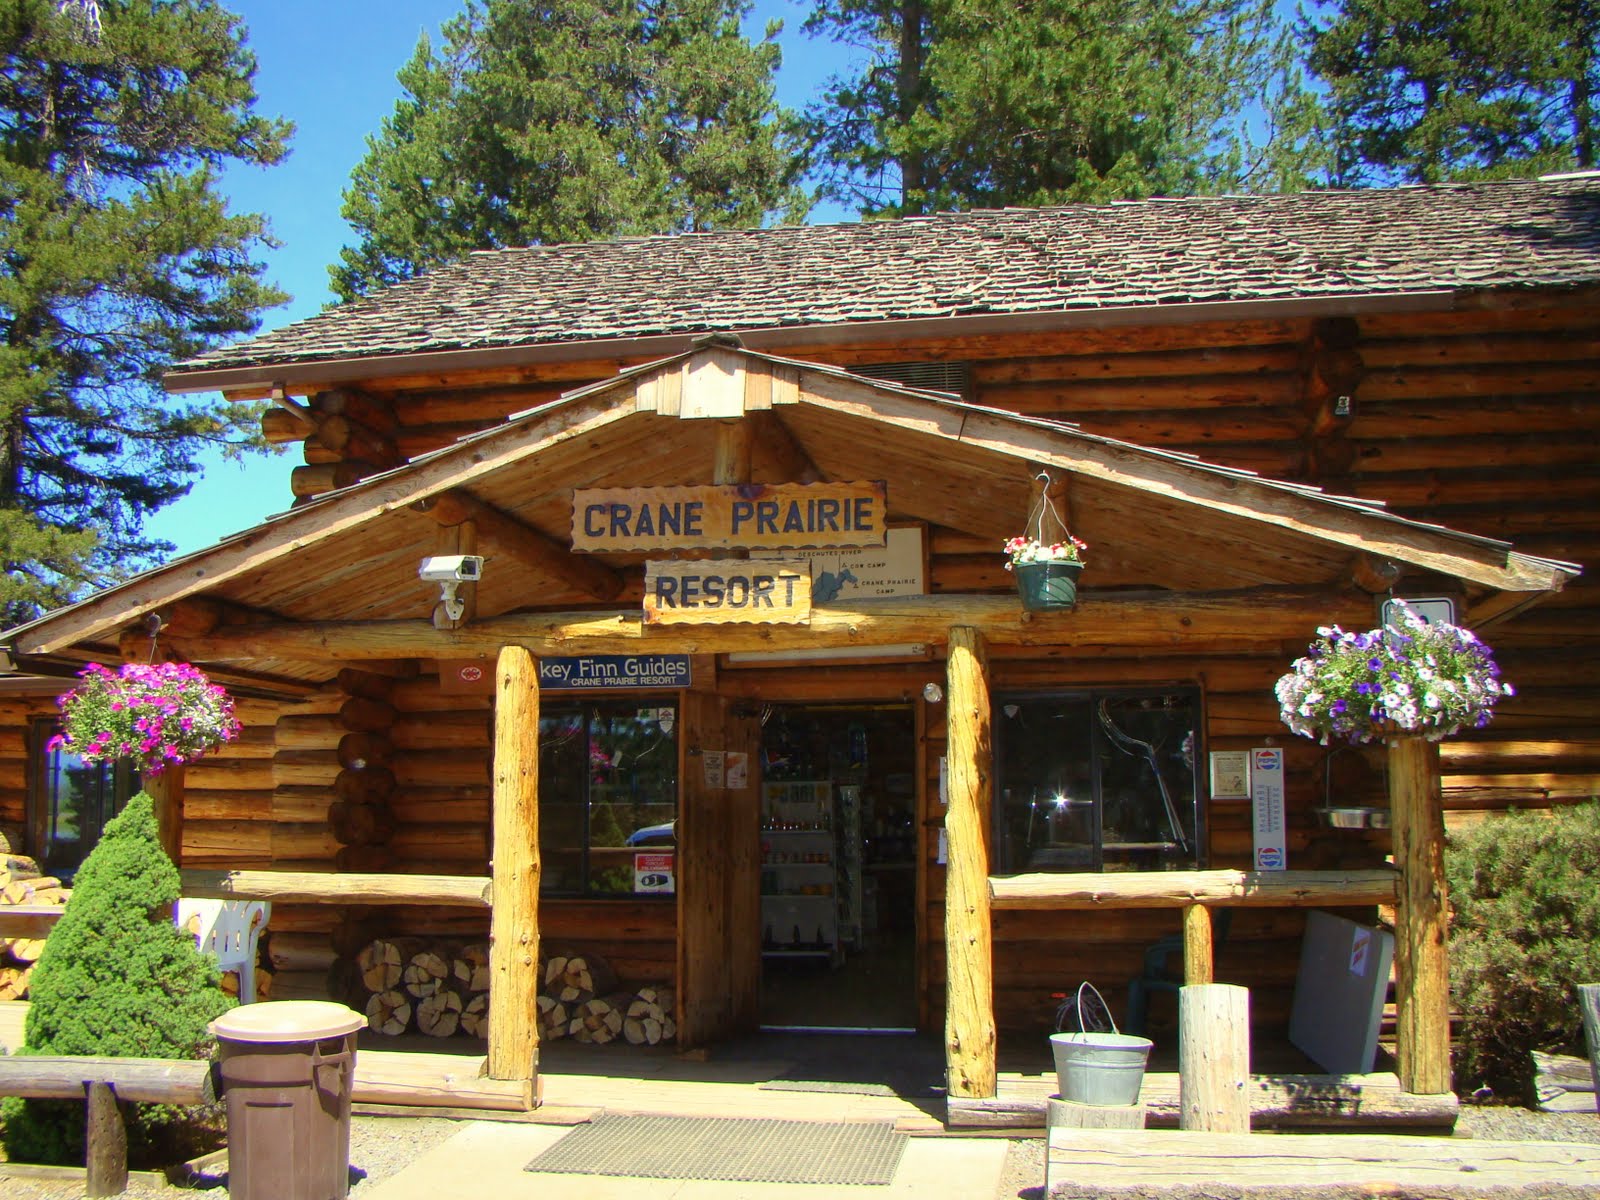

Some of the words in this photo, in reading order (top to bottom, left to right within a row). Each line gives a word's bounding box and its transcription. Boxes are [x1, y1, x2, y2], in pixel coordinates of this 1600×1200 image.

[584, 502, 703, 537] CRANE
[731, 497, 874, 535] PRAIRIE
[655, 574, 801, 610] RESORT
[571, 677, 602, 687] CRANE
[604, 676, 638, 686] PRAIRIE
[640, 675, 677, 685] RESORT
[578, 659, 618, 677] Finn
[624, 658, 686, 676] Guides
